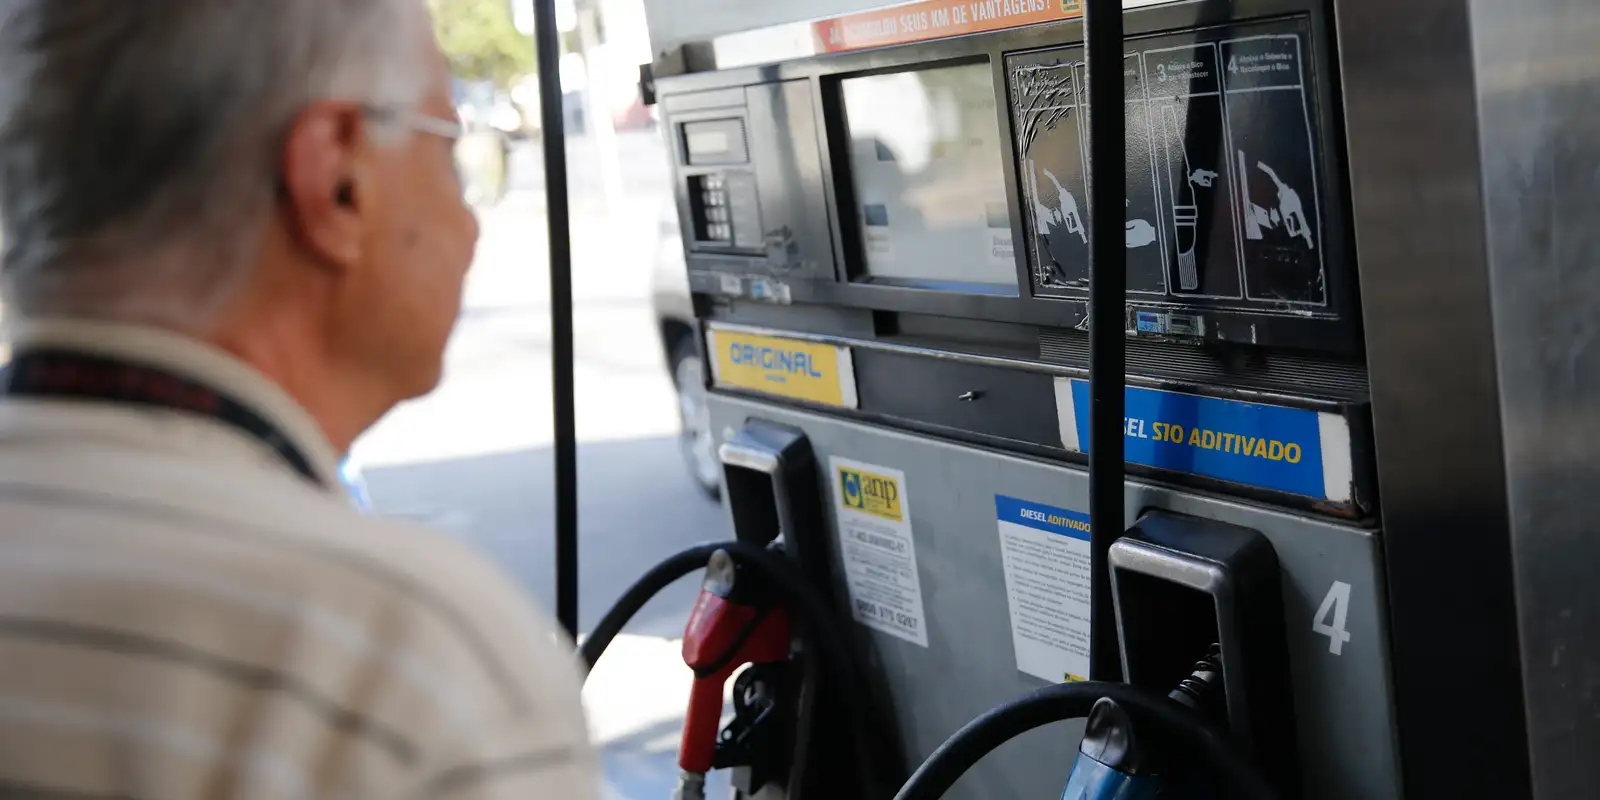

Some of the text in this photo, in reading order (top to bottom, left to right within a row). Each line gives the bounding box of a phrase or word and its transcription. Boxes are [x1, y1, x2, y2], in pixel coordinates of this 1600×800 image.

[900, 11, 928, 32] SEUS
[931, 9, 950, 28] KM
[953, 7, 968, 25] DE
[1156, 63, 1167, 82] 3
[1190, 61, 1204, 69] Bico
[1227, 54, 1239, 74] 4
[730, 342, 822, 378] ORIGINAL
[1152, 421, 1184, 442] S10
[1188, 428, 1302, 464] ADITIVADO
[863, 475, 898, 509] anp
[1020, 507, 1092, 533] DIESEL ADITIVADO
[1312, 580, 1352, 656] 4
